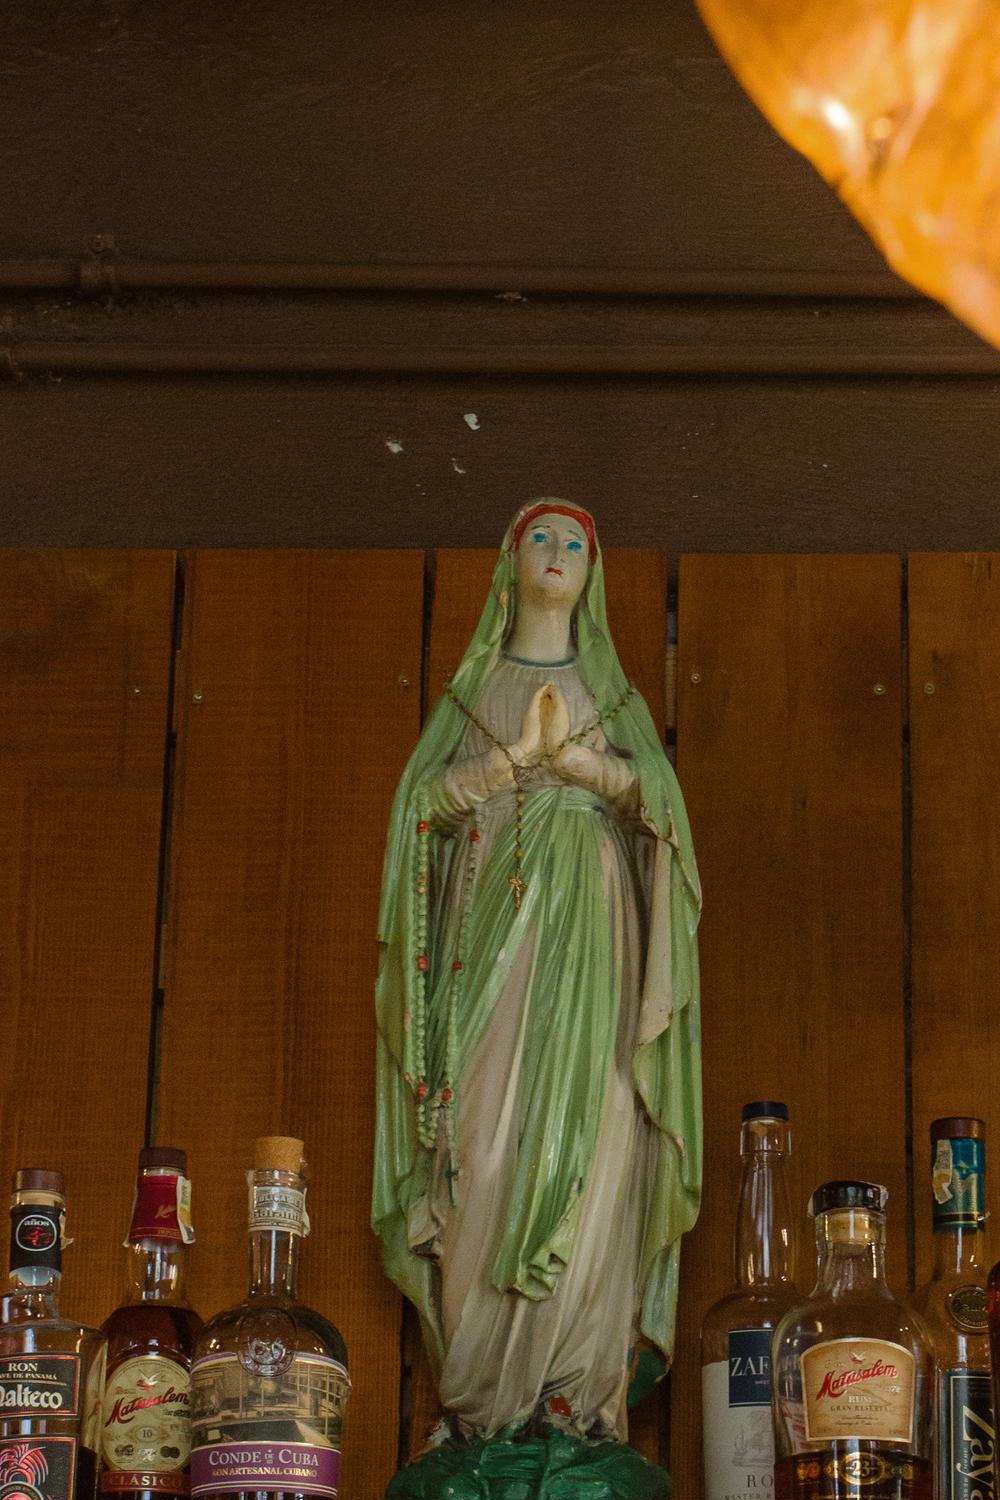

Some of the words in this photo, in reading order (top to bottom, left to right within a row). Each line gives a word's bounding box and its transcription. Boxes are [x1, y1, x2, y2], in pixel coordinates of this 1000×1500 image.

[8, 1362, 39, 1372] RON
[815, 1359, 898, 1401] Matusalem
[104, 1386, 190, 1428] Matusalem
[208, 1451, 262, 1466] CONDE
[278, 1448, 320, 1467] CUBA
[229, 1467, 283, 1476] ARTESANAL
[284, 1468, 318, 1478] CUBANO
